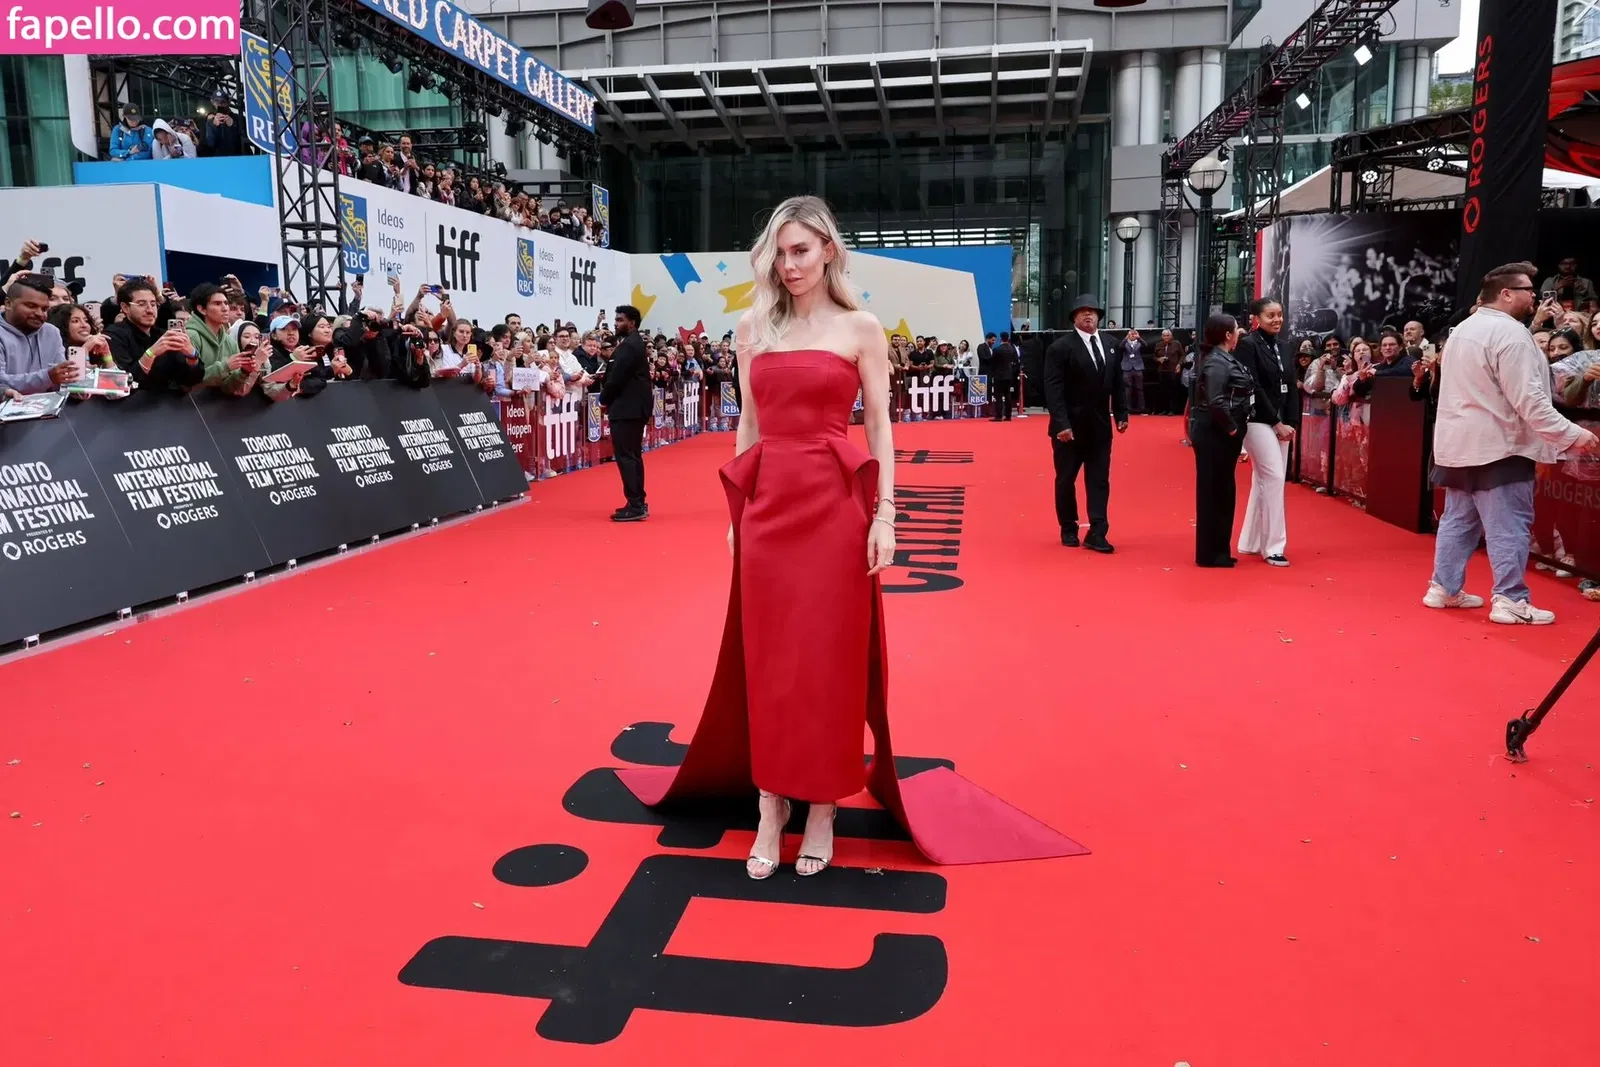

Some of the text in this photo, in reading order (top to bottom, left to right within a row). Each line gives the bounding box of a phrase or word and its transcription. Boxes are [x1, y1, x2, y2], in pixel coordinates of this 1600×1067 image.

[372, 0, 598, 127] ED CARPET GALLERY
[1469, 34, 1493, 188] ROGERS
[377, 208, 404, 229] Ideas
[378, 232, 415, 255] Happen
[539, 247, 554, 262] Ideas
[343, 250, 368, 270] RBC
[436, 224, 480, 292] tiff
[539, 265, 559, 281] Happen
[570, 256, 596, 307] tiff
[518, 280, 533, 293] RBC
[683, 382, 700, 427] tiff
[908, 375, 954, 413] tiff
[506, 404, 525, 418] Ideas
[331, 424, 372, 442] TORONTO
[400, 418, 434, 433] TORONTO
[506, 423, 532, 438] Happen
[544, 392, 578, 459] tiff
[241, 433, 292, 453] TORONTO
[326, 437, 390, 459] INTERNATIONAL
[398, 429, 450, 448] INTERNATIONAL
[510, 442, 523, 453] ere
[123, 445, 190, 469] TORONTO
[234, 447, 315, 473] INTERNATIONAL
[336, 451, 395, 473] FILM FESTIVAL
[405, 442, 454, 461] FILM FESTIVAL
[113, 461, 218, 492] INTERNATIONAL
[246, 463, 320, 489] FILM FESTIVAL
[429, 459, 453, 472] ROGERS
[363, 470, 393, 485] ROGERS
[126, 479, 224, 511] FILM FESTIVAL
[280, 485, 317, 502] ROGERS
[1543, 479, 1600, 509] ROGERS
[12, 500, 95, 531] FESTIVAL
[170, 505, 219, 526] ROGERS
[22, 530, 87, 556] ROGERS
